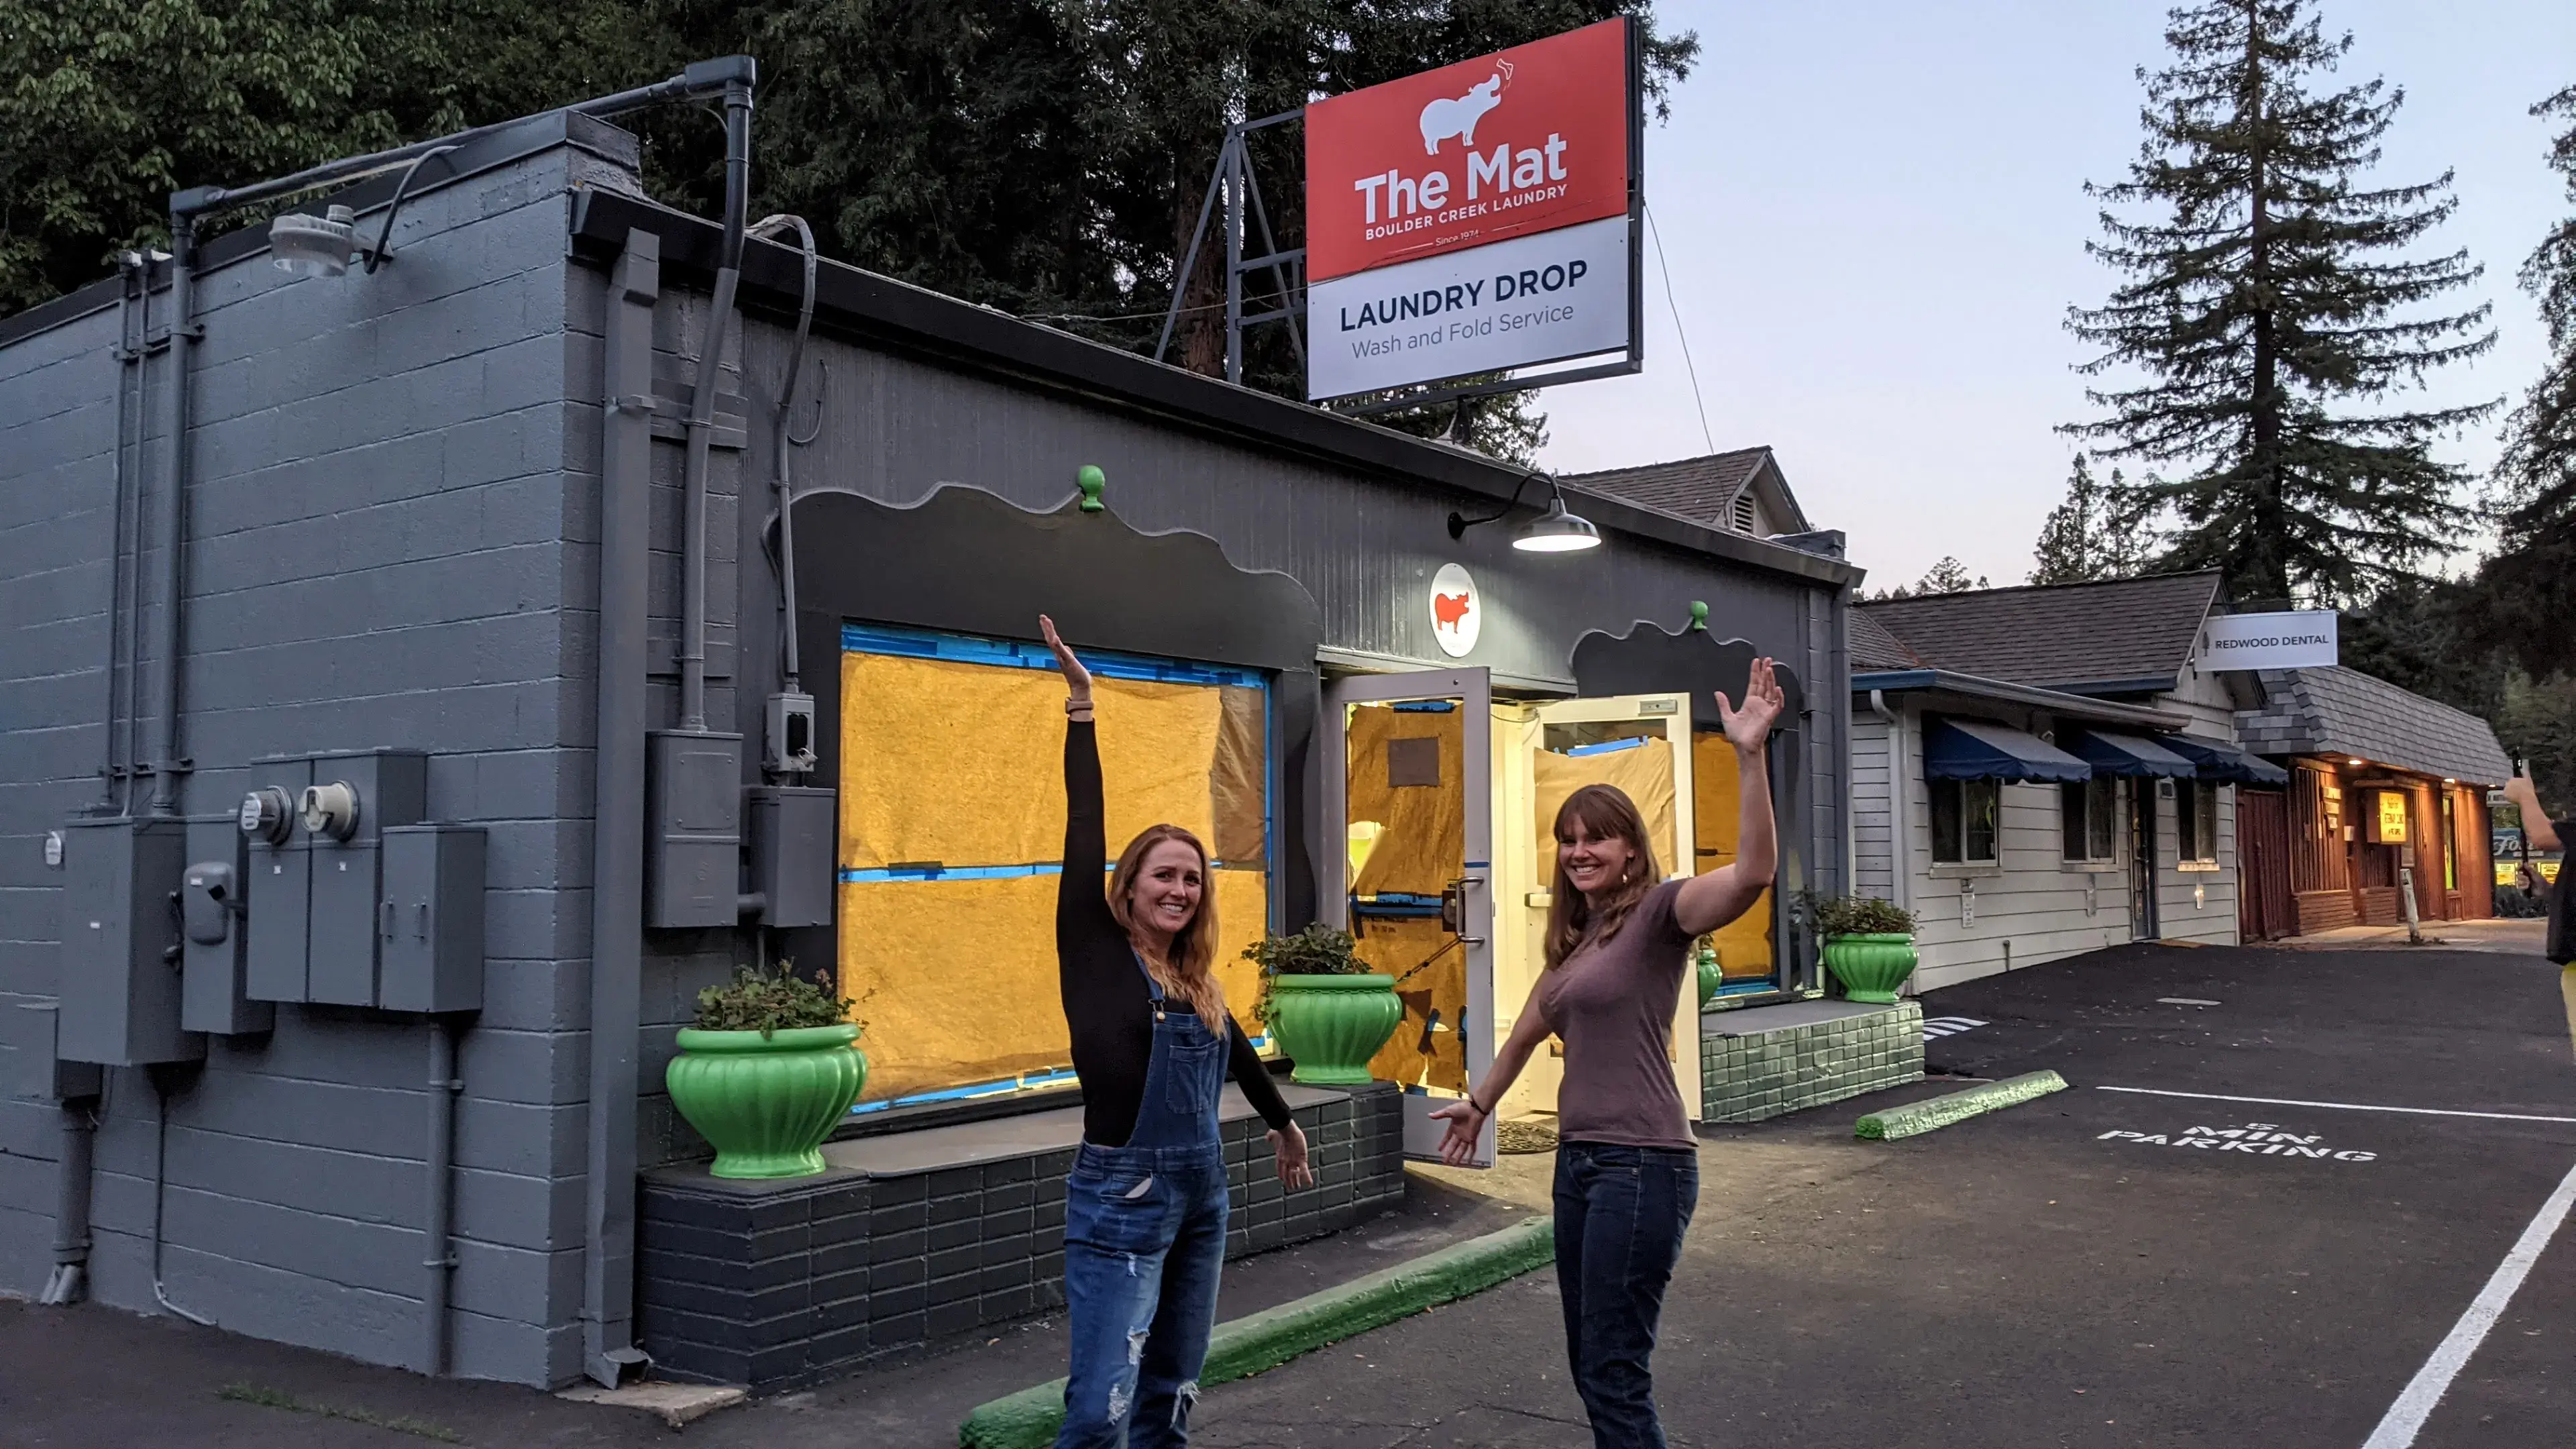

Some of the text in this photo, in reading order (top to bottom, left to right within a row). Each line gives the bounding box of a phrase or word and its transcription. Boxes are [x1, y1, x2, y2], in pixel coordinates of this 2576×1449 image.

[1354, 133, 1567, 224] The Mat
[1366, 184, 1568, 241] BOULDER CREEK LAUNDRY
[1436, 229, 1479, 246] Since 1974
[1341, 260, 1587, 331] LAUNDRY DROP
[1352, 305, 1574, 359] Wash and Fold Service
[2215, 635, 2328, 649] REDWOOD DENTAL
[2096, 1130, 2378, 1161] PARKING
[2182, 1126, 2324, 1144] MIN
